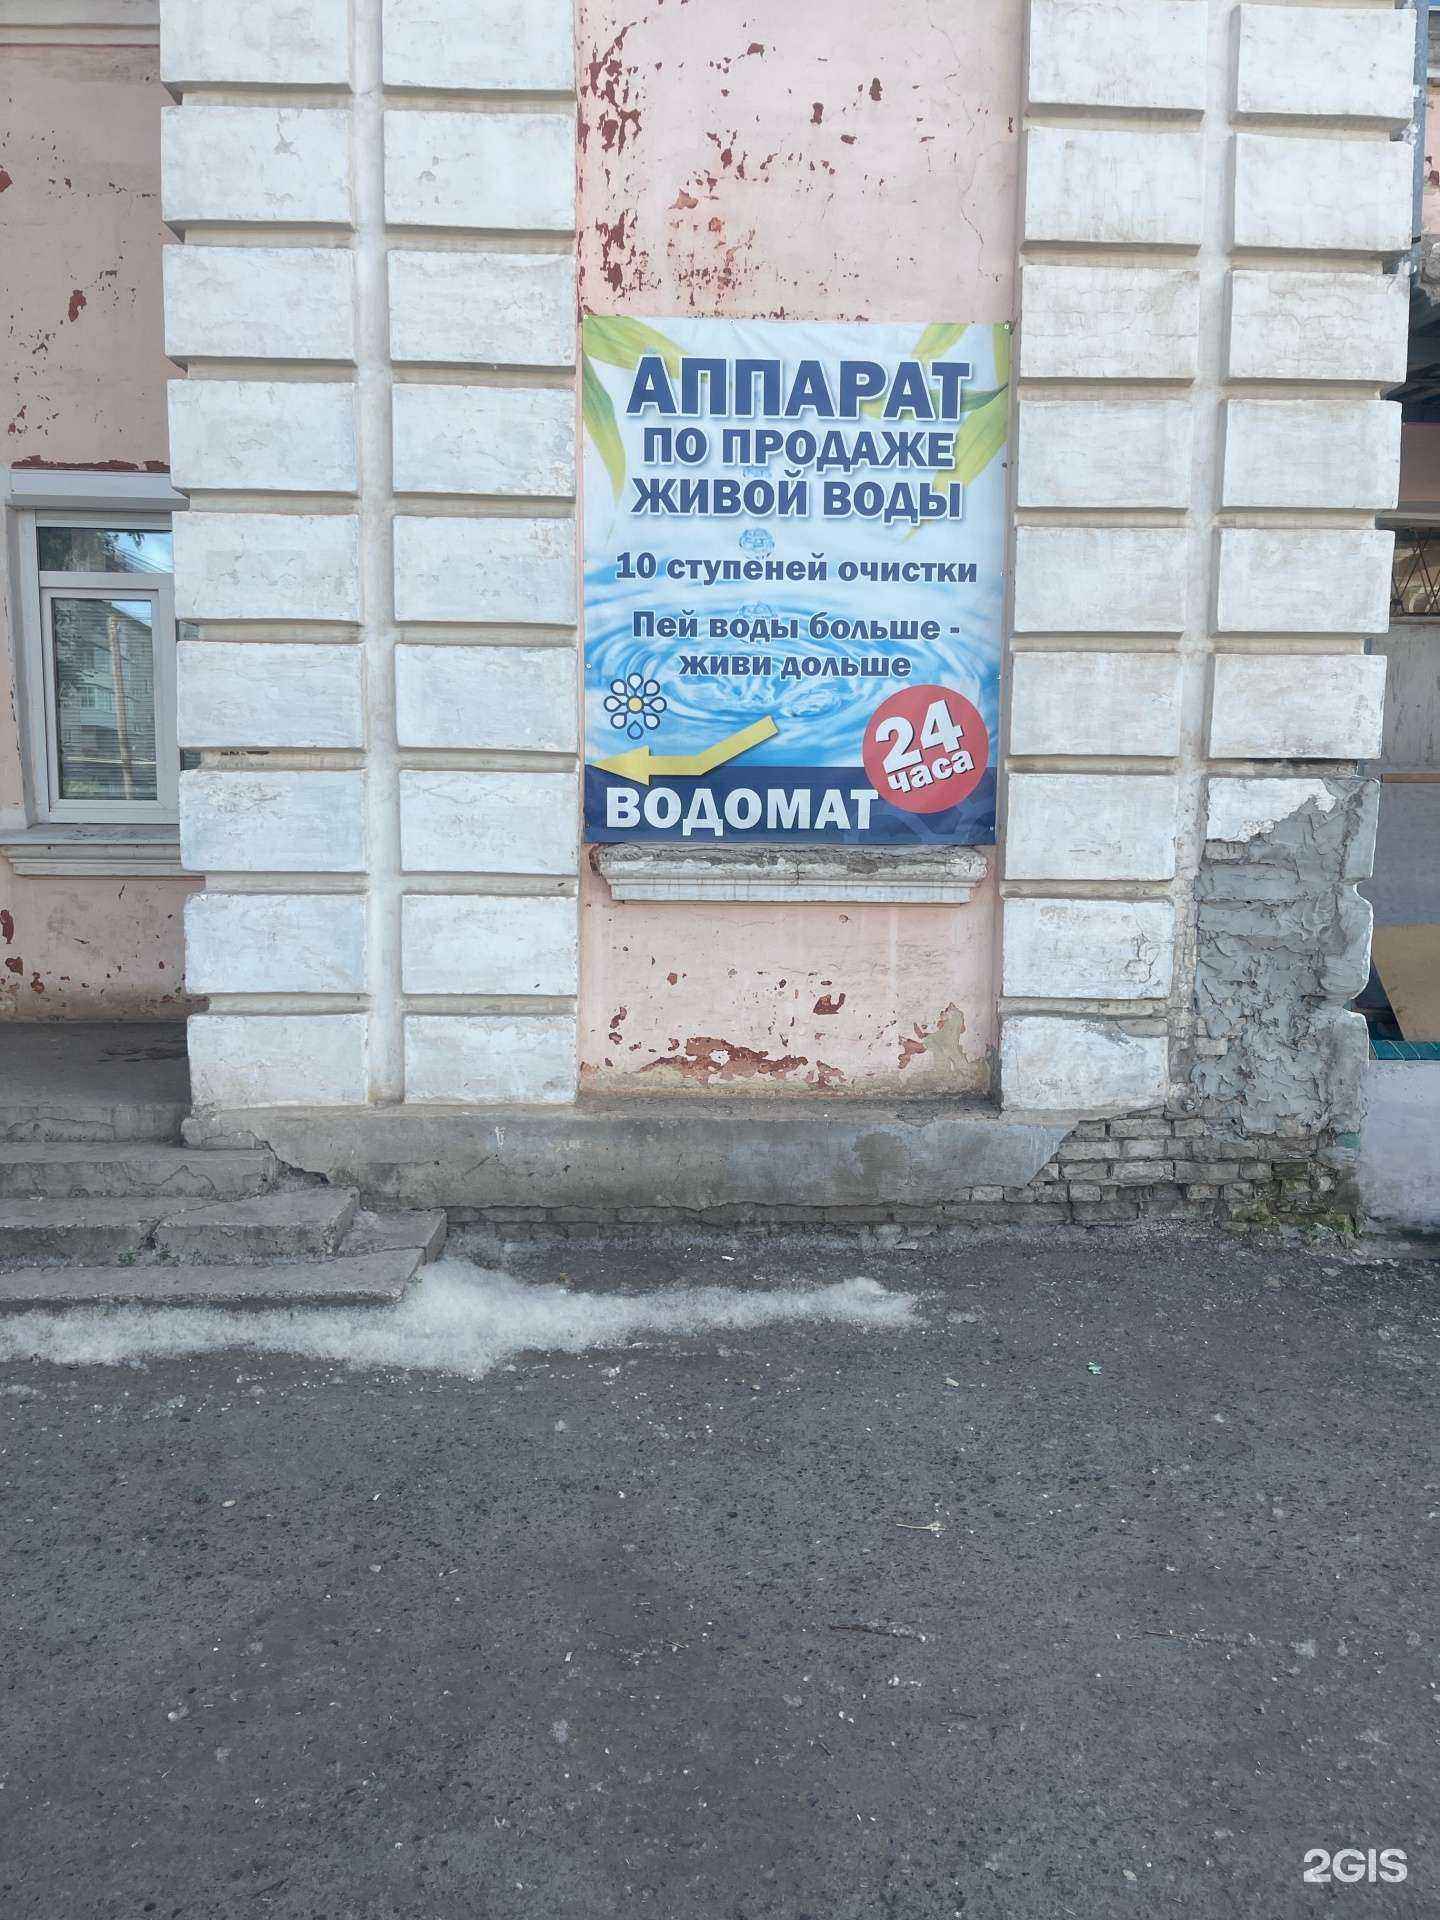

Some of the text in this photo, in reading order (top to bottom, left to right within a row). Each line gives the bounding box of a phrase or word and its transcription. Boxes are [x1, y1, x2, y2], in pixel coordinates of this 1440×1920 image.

[626, 356, 970, 419] АППАРАТ
[644, 428, 954, 472] ПО ПРОДАЖЕ
[631, 470, 961, 523] ЖИВОЙ ВОДЫ
[617, 553, 977, 584] 10 ступеней очистки
[633, 610, 698, 638] Пей
[709, 617, 798, 642] воды
[809, 612, 940, 639] больше
[679, 655, 912, 680] живи дольше
[875, 699, 964, 774] 24
[888, 748, 975, 793] часа
[606, 787, 879, 836] ВОДОМАТ
